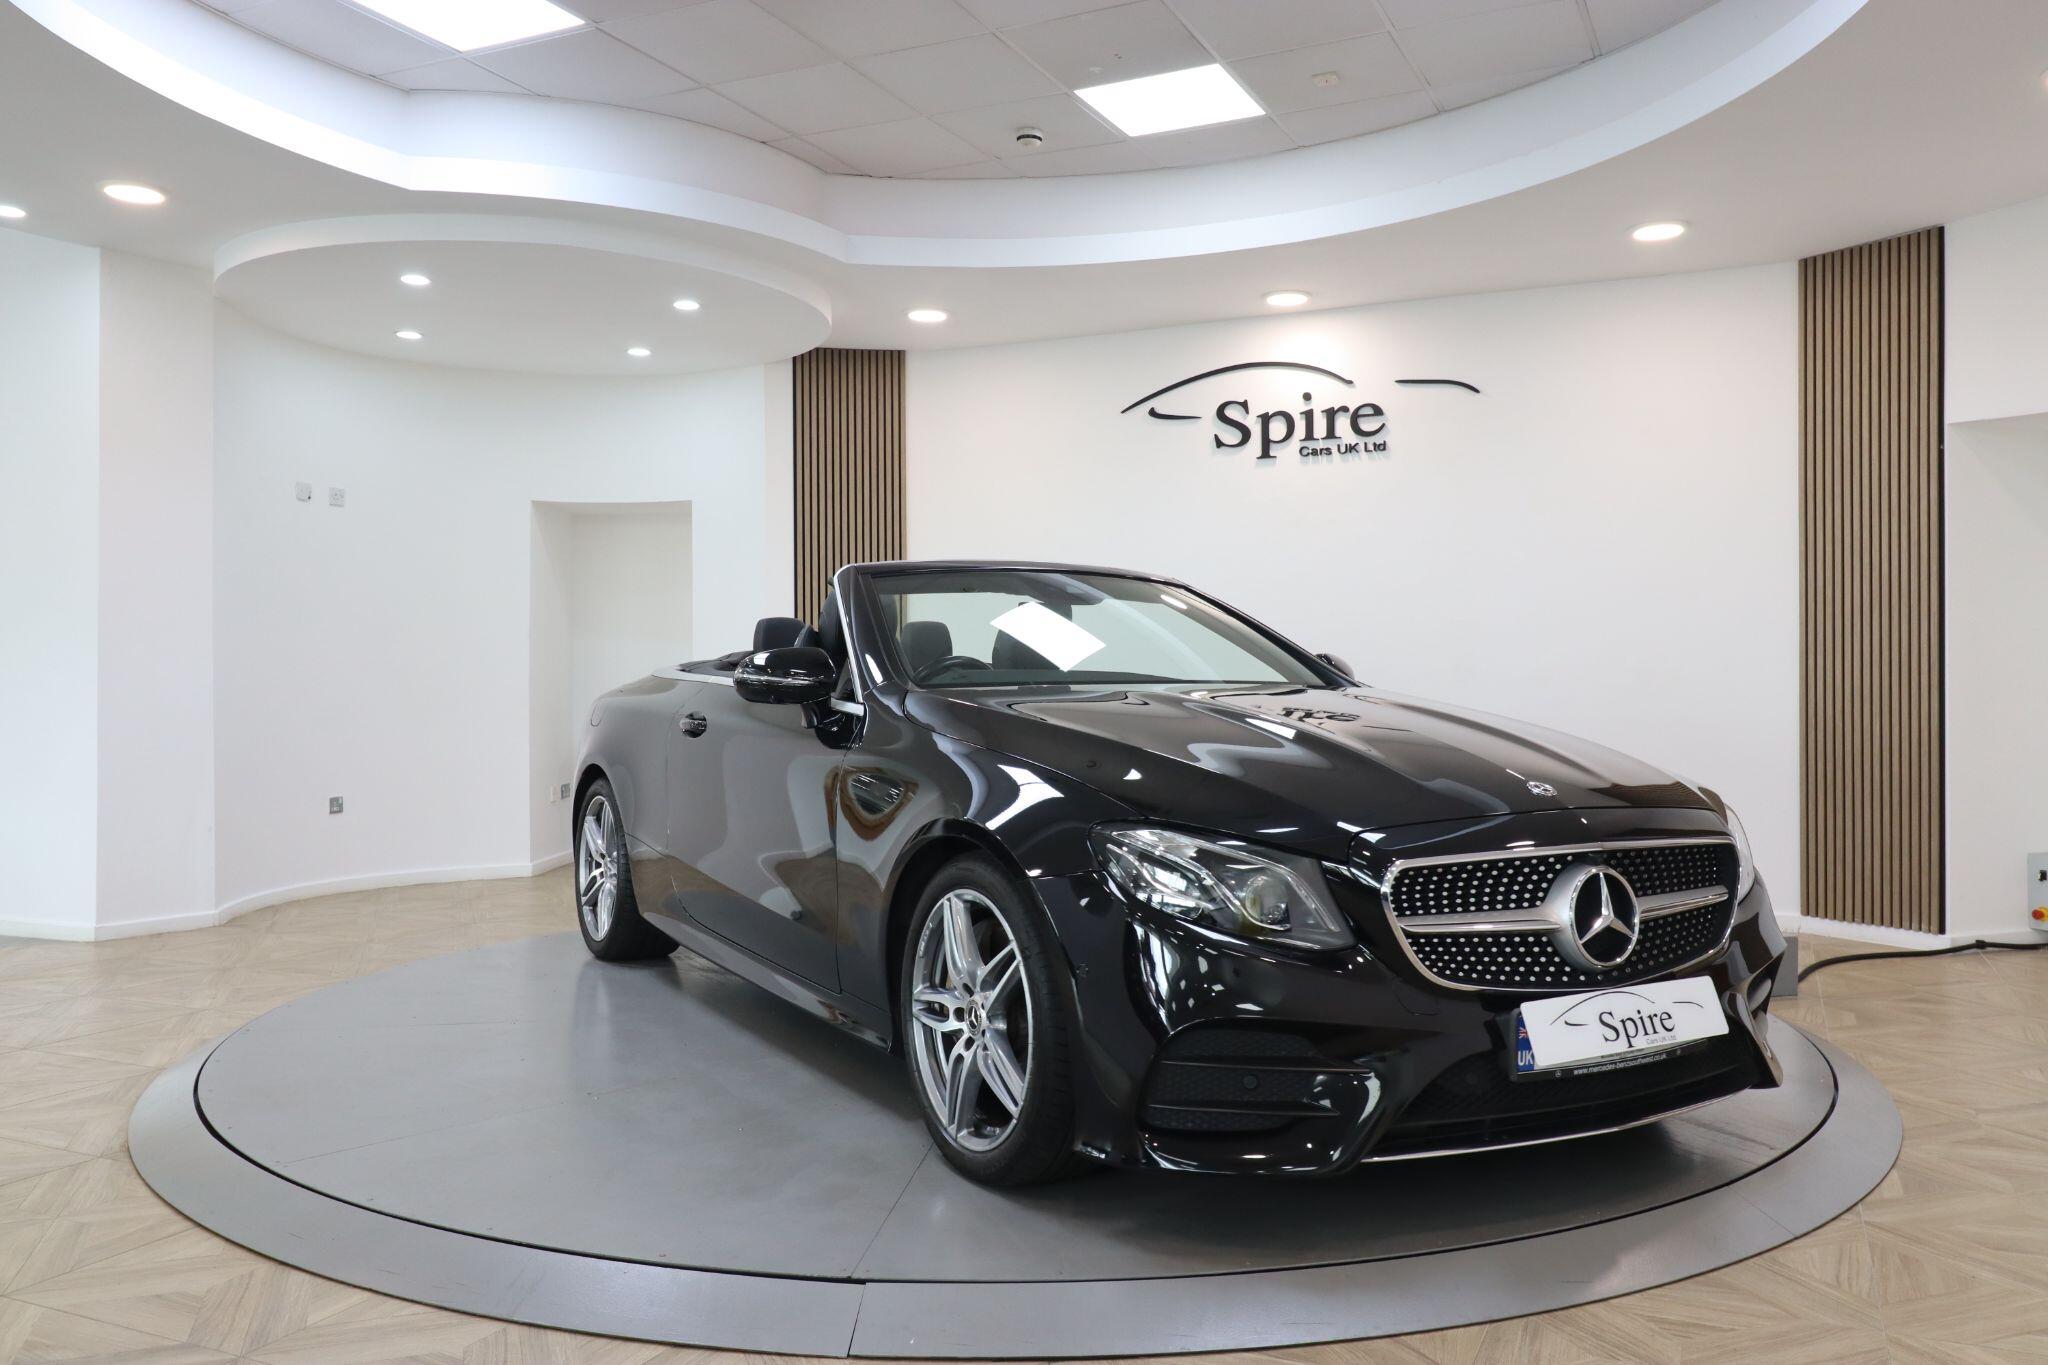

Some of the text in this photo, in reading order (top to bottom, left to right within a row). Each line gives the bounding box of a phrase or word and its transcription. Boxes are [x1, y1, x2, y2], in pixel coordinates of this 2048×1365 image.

[1214, 392, 1386, 460] Spire
[1299, 440, 1386, 457] Cars UK Ltd
[1598, 1009, 1676, 1048] Spire
[1517, 1050, 1534, 1066] UK
